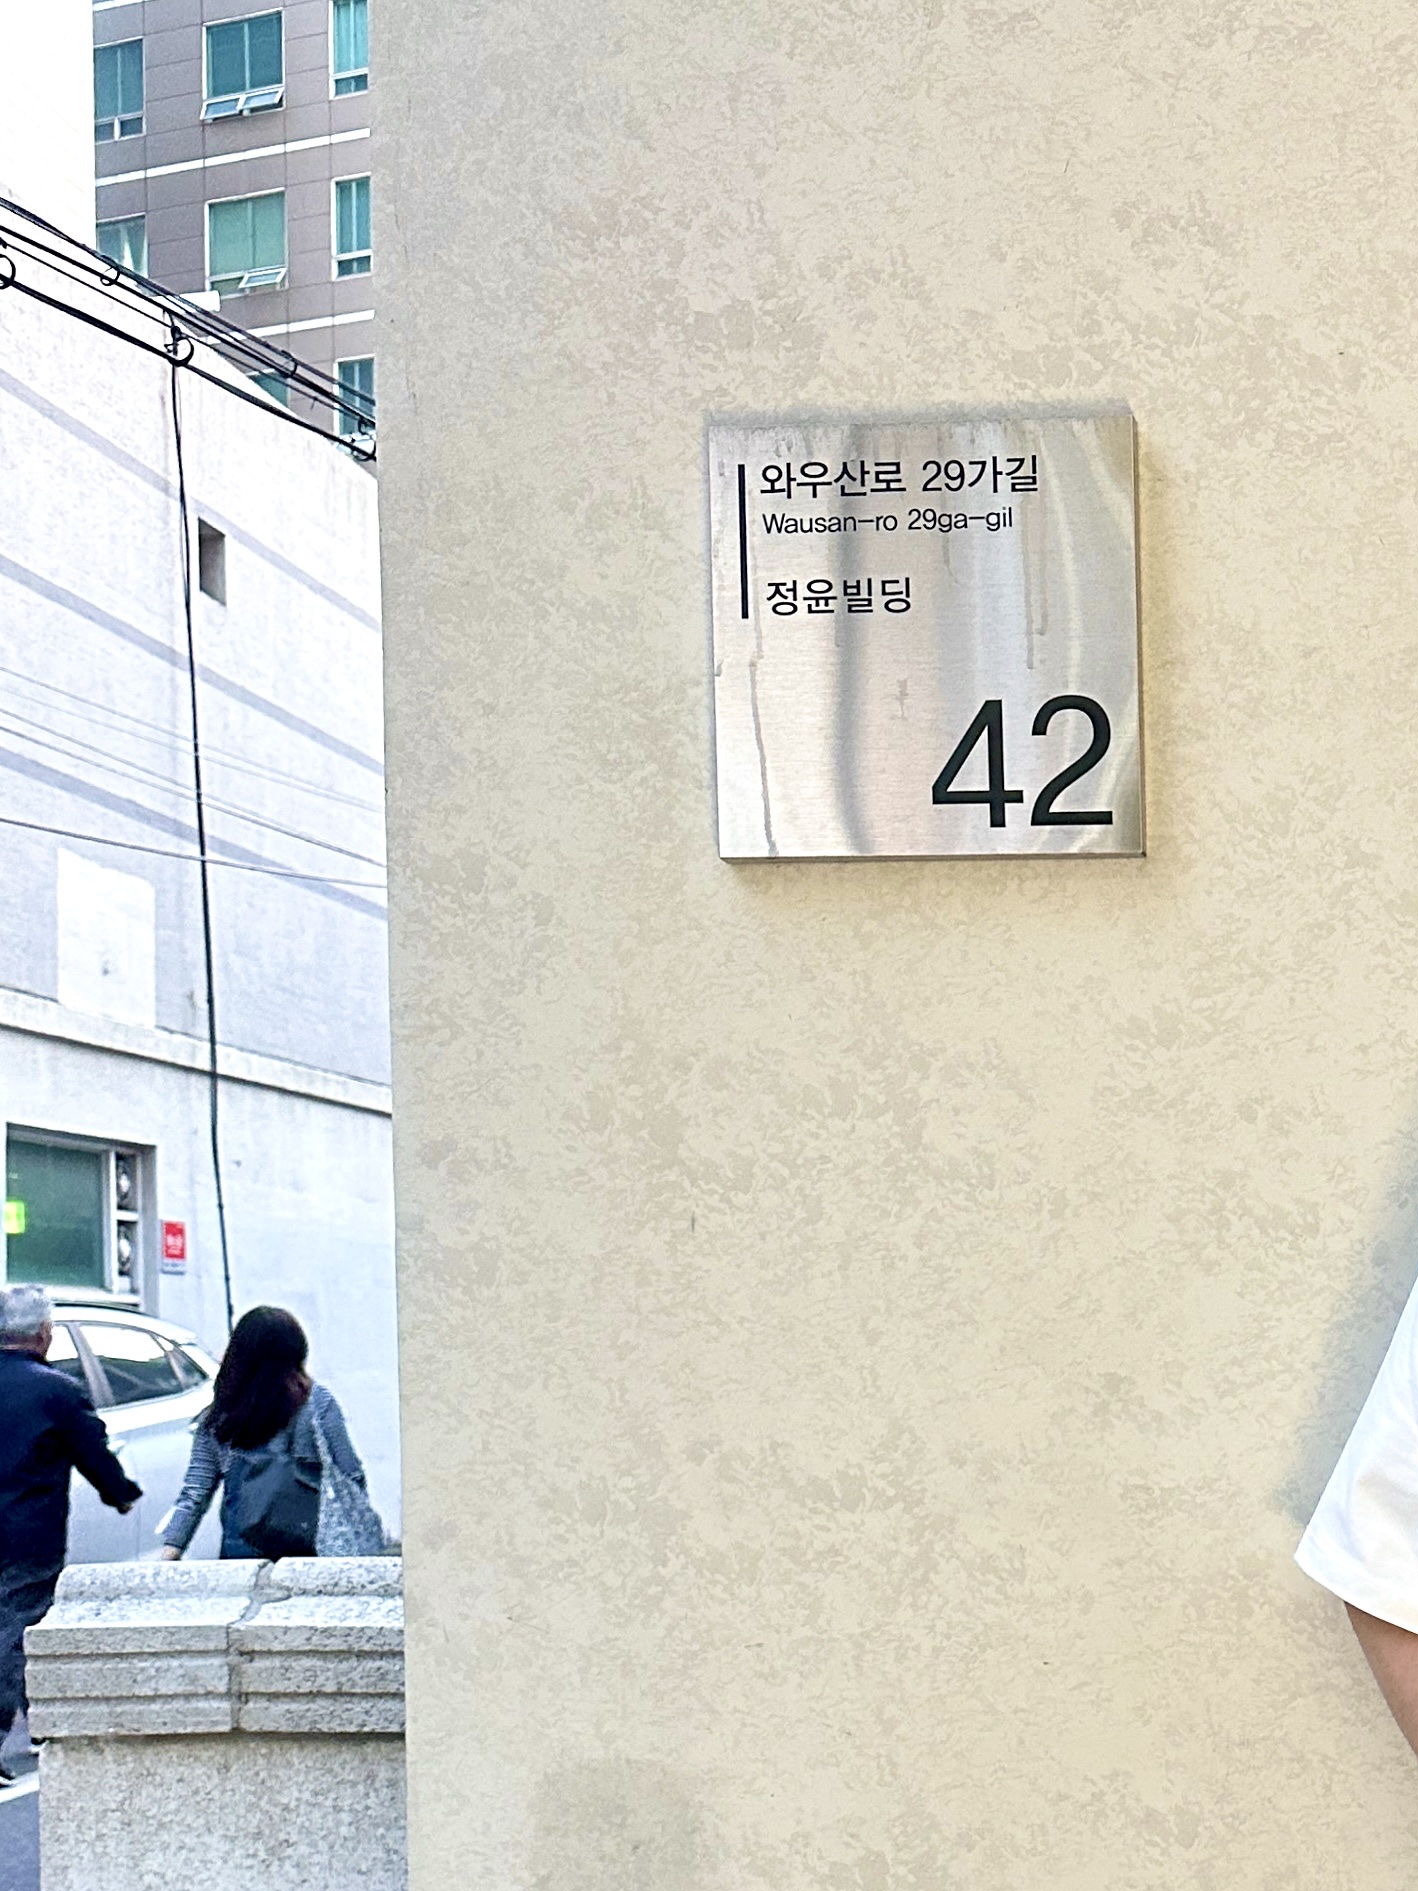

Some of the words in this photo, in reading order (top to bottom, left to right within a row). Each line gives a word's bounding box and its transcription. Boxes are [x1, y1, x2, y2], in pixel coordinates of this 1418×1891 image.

[760, 459, 907, 500] 와우산로
[921, 454, 1039, 494] 29가길
[762, 512, 898, 535] Wausan-ro
[907, 506, 1014, 534] 29ga-gil
[766, 577, 912, 616] 정윤빌딩
[931, 694, 1114, 828] 42
